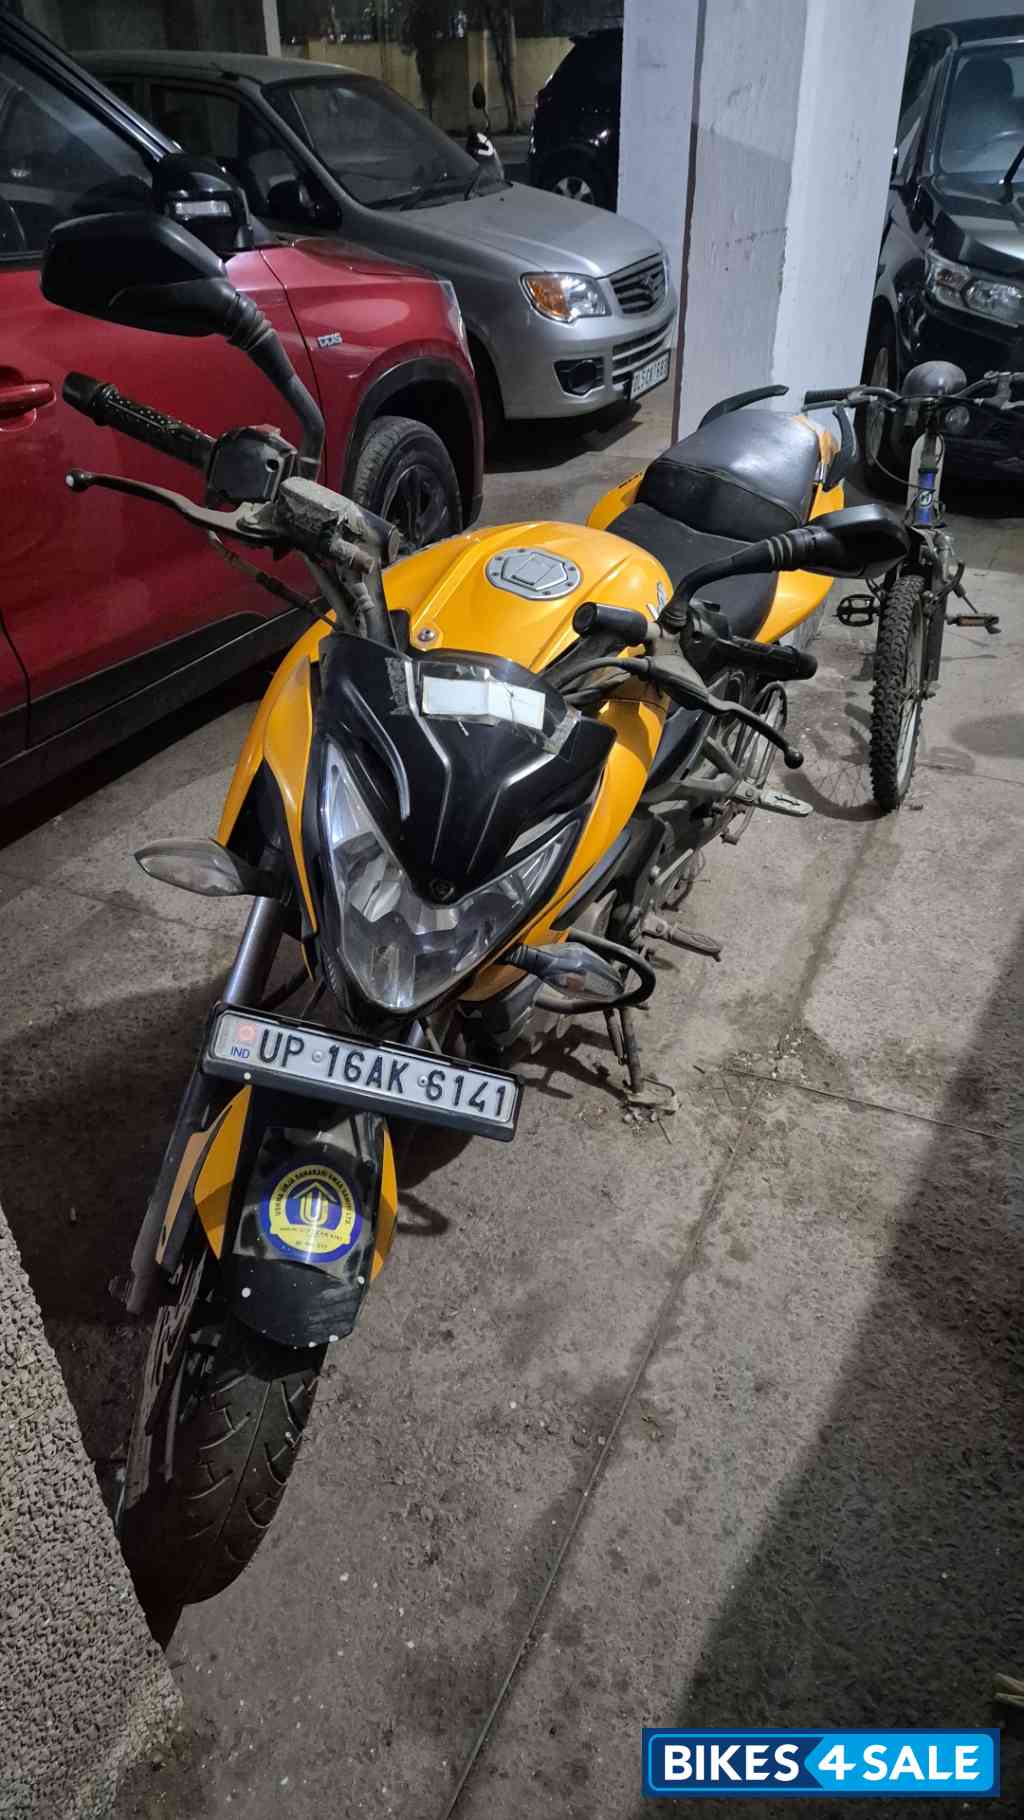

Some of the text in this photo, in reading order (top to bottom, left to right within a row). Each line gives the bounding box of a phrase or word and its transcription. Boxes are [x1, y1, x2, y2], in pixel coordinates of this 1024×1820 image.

[230, 1046, 251, 1060] IND
[259, 1029, 506, 1116] UP 16AK 6141
